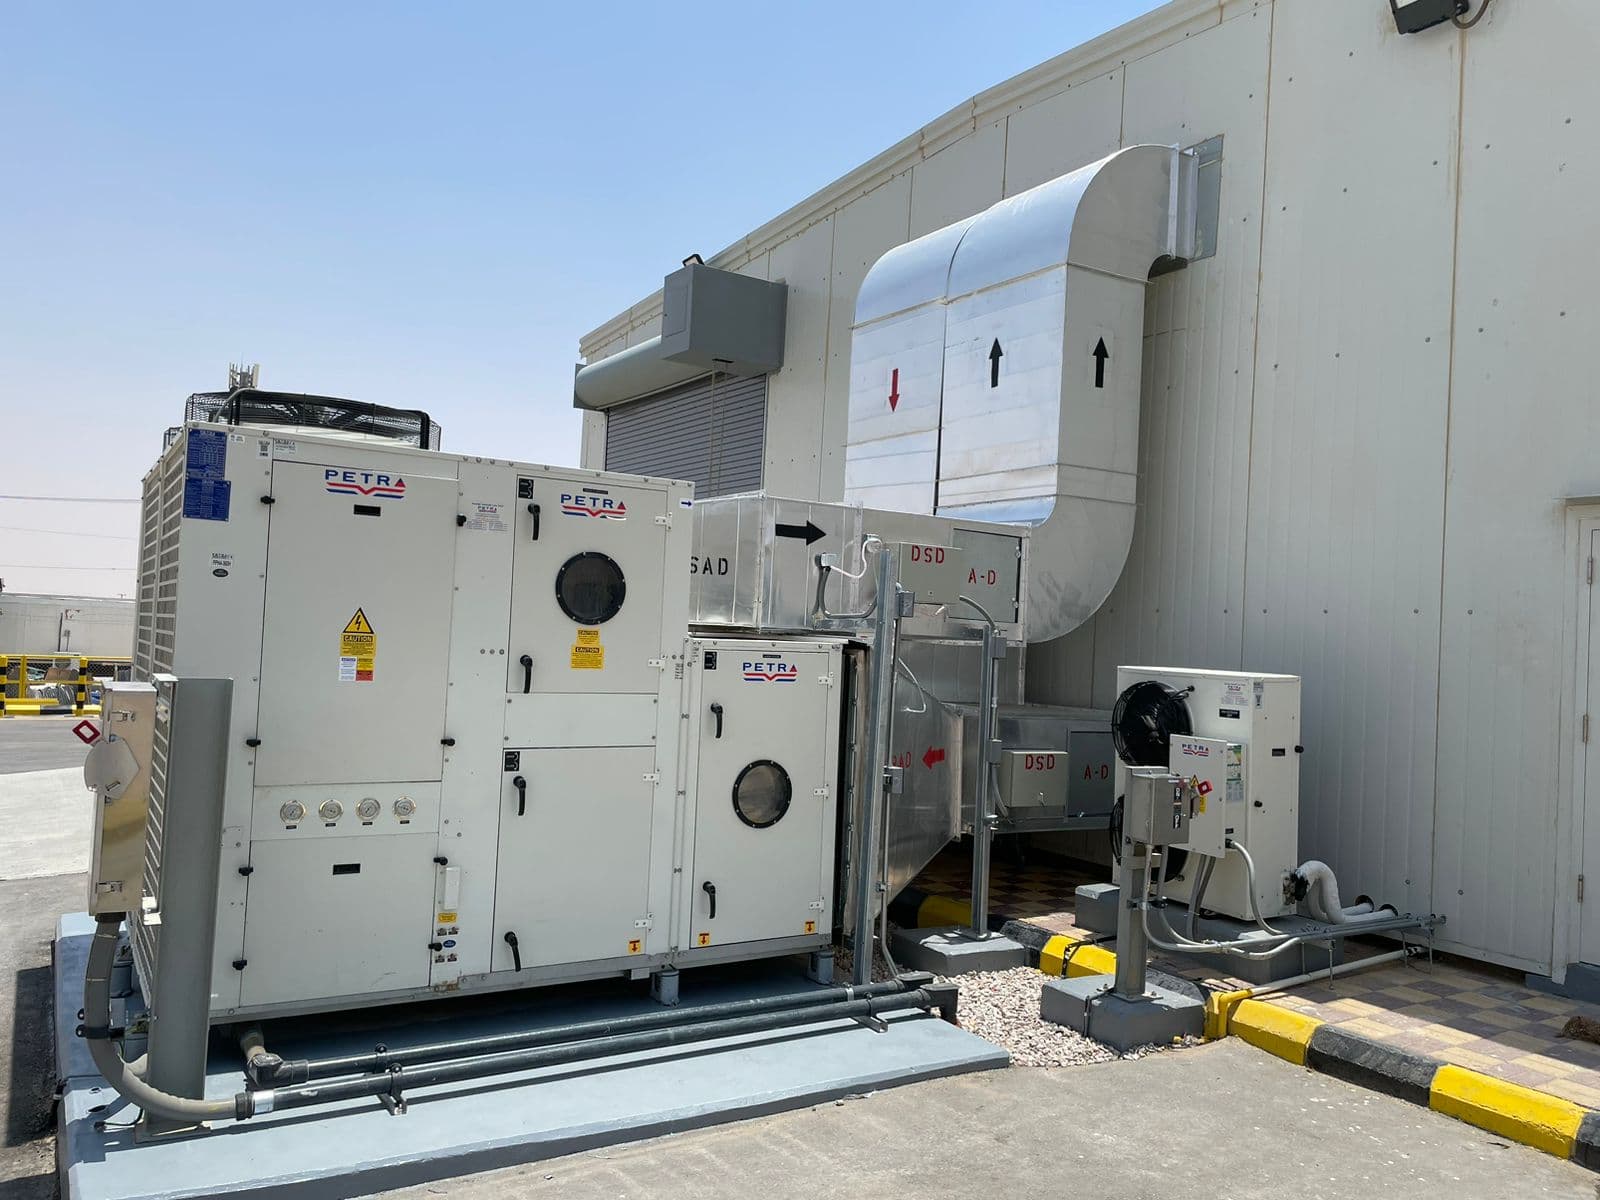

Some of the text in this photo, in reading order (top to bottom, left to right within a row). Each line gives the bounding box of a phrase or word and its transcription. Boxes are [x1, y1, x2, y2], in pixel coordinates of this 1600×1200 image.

[325, 469, 406, 488] PETRA
[560, 493, 627, 510] PETRA
[911, 544, 945, 564] DSD
[968, 568, 996, 585] A-D
[742, 662, 798, 673] PETRA
[1181, 743, 1209, 752] PETRA
[1025, 753, 1056, 771] DSD
[1084, 764, 1109, 780] A-D
